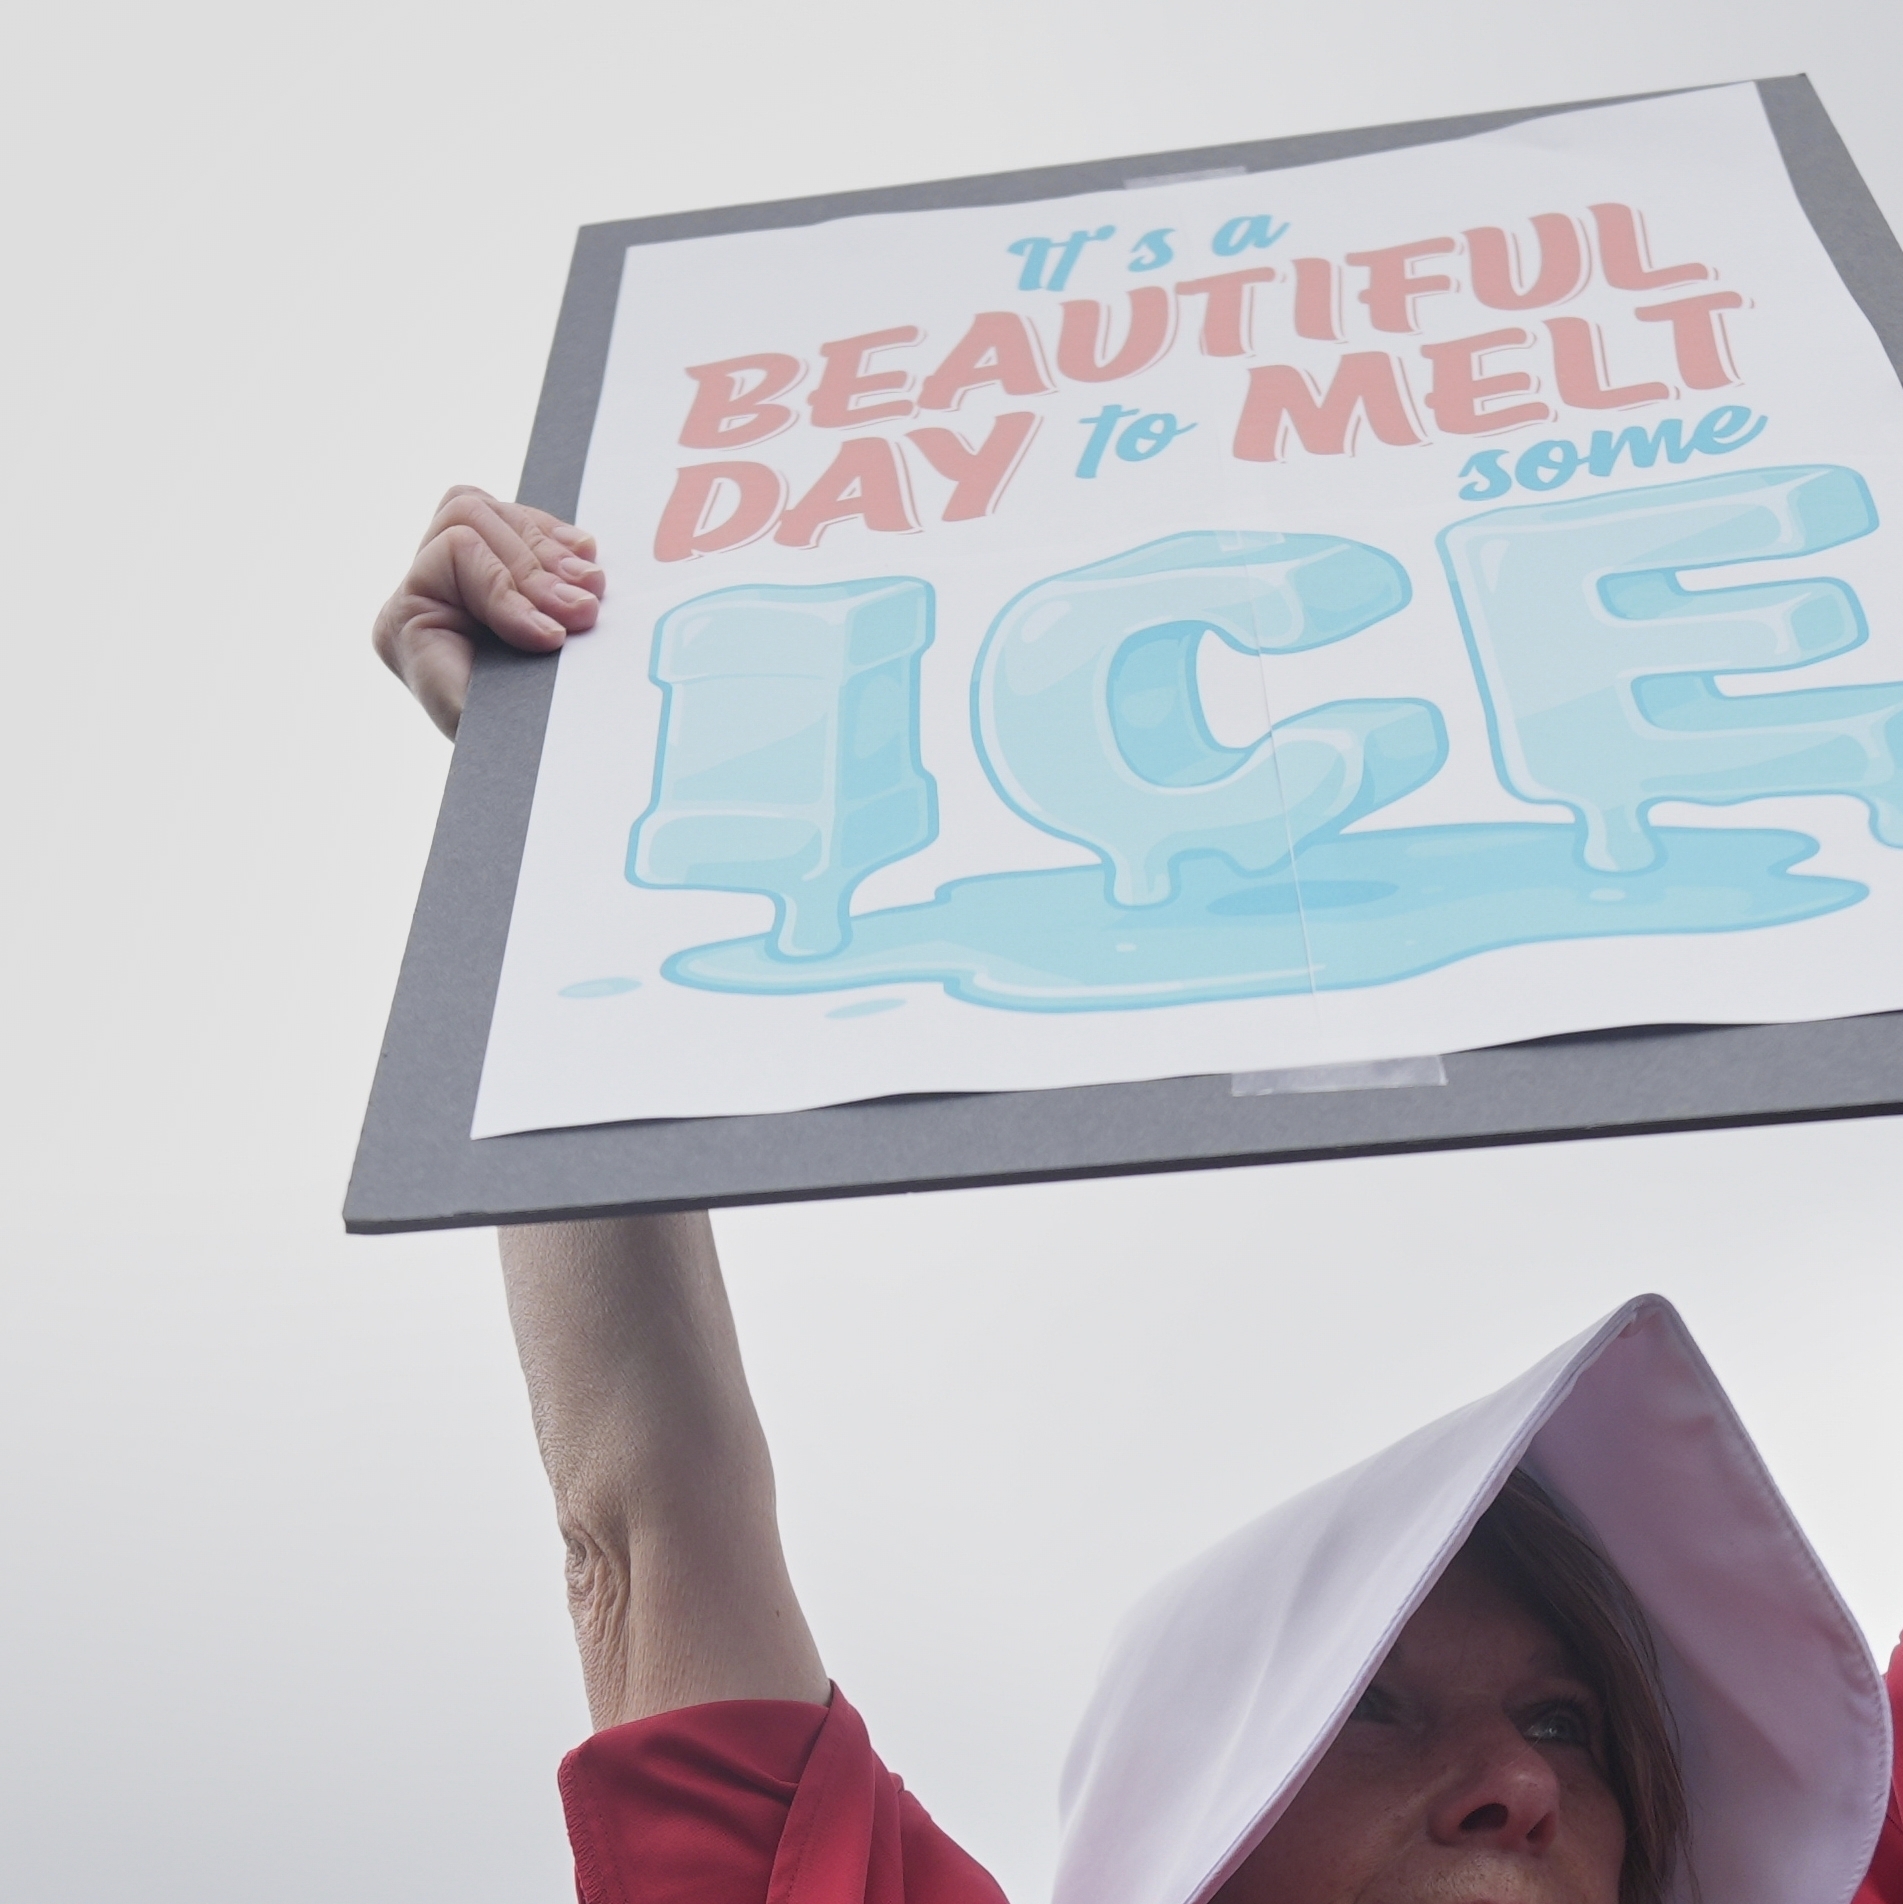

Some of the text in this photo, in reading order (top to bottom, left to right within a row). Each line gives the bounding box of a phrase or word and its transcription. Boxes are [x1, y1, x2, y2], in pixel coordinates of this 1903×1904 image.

[677, 201, 1712, 453] BEAUTIFUL
[1006, 212, 1292, 293] It's a
[652, 289, 1758, 564] DAY to MELT
[1457, 403, 1769, 502] some
